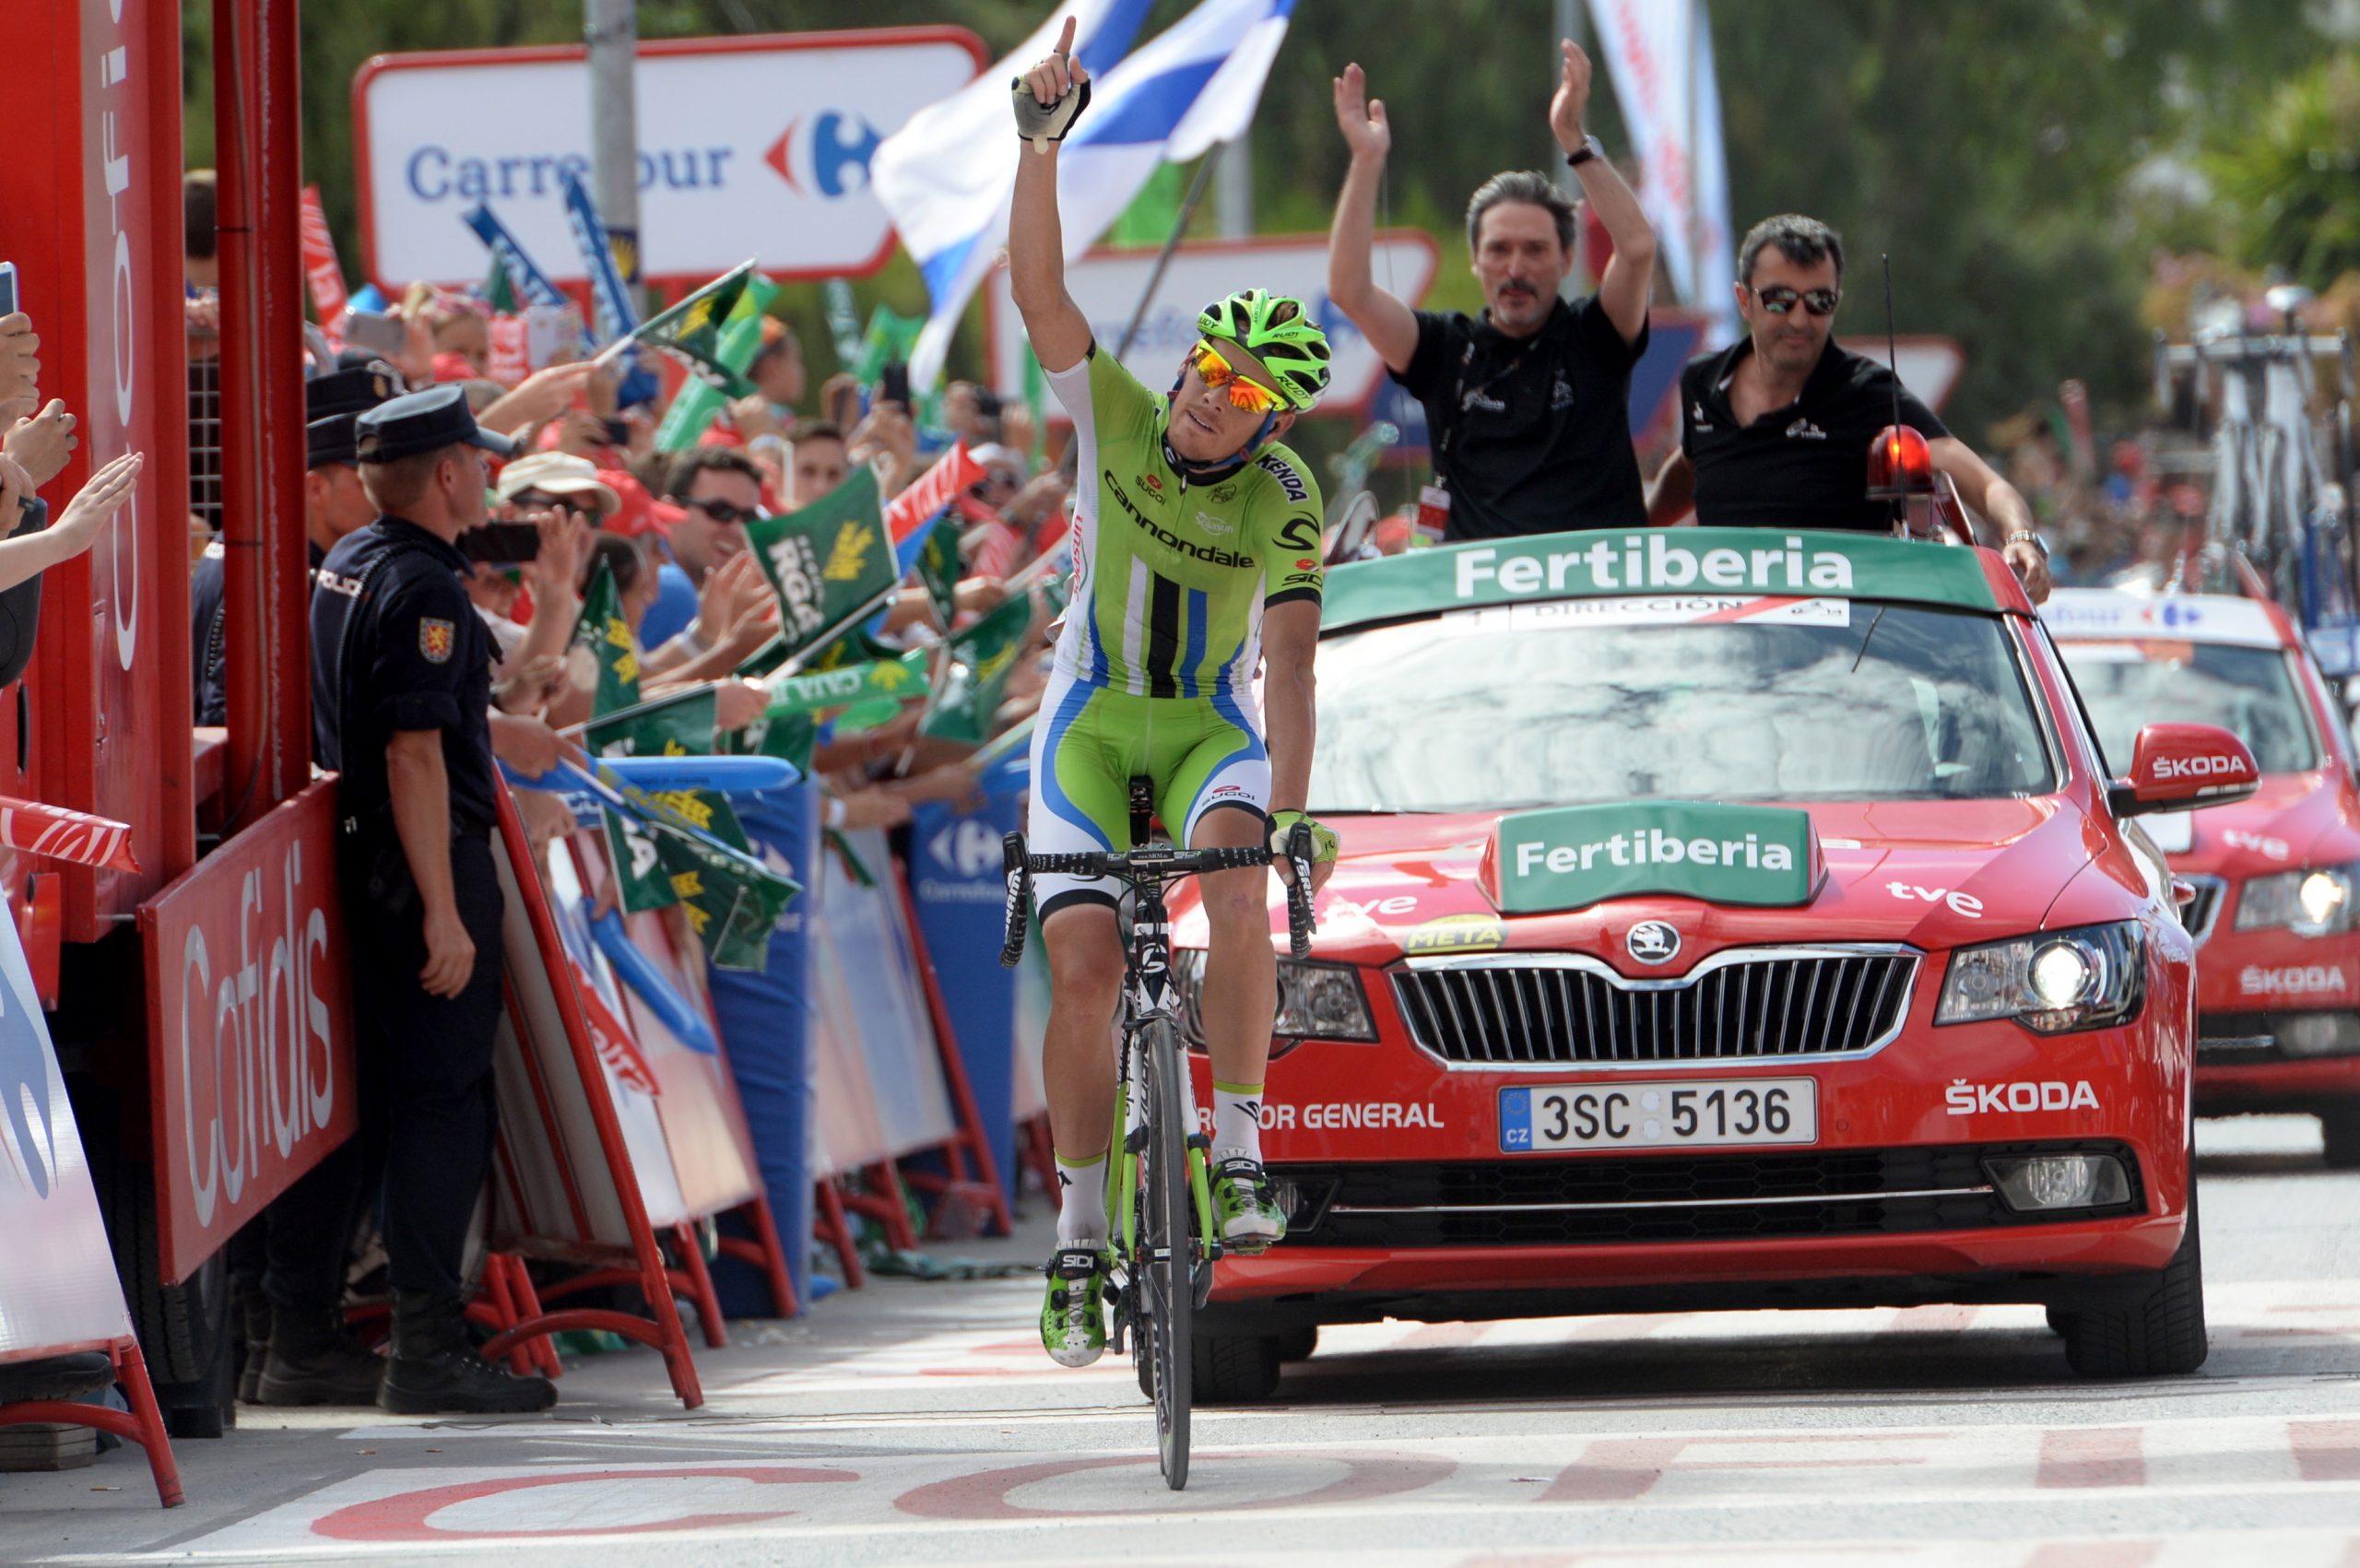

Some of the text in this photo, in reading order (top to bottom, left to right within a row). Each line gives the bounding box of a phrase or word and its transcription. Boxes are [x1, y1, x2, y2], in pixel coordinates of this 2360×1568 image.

[406, 146, 733, 203] Carreour
[1275, 374, 1309, 400] RUDY
[1256, 453, 1309, 502] KENDA
[1104, 469, 1255, 569] cannondale
[1455, 535, 1854, 597] Fertiberia
[1534, 595, 1743, 618] DIRECCIÓN
[2153, 754, 2247, 780] ŠKODA
[1516, 828, 1793, 877] Fertiberia
[2223, 828, 2289, 861] tve
[1886, 880, 1984, 919] tve
[1408, 927, 1503, 948] META
[2240, 963, 2346, 996] ŠKODA
[181, 840, 334, 1228] Cofidis
[1542, 1088, 1791, 1142] 3SC 5136
[1945, 1079, 2100, 1115] ŠKODA
[1304, 1102, 1446, 1129] GENERAL
[1505, 1129, 1528, 1146] CZ
